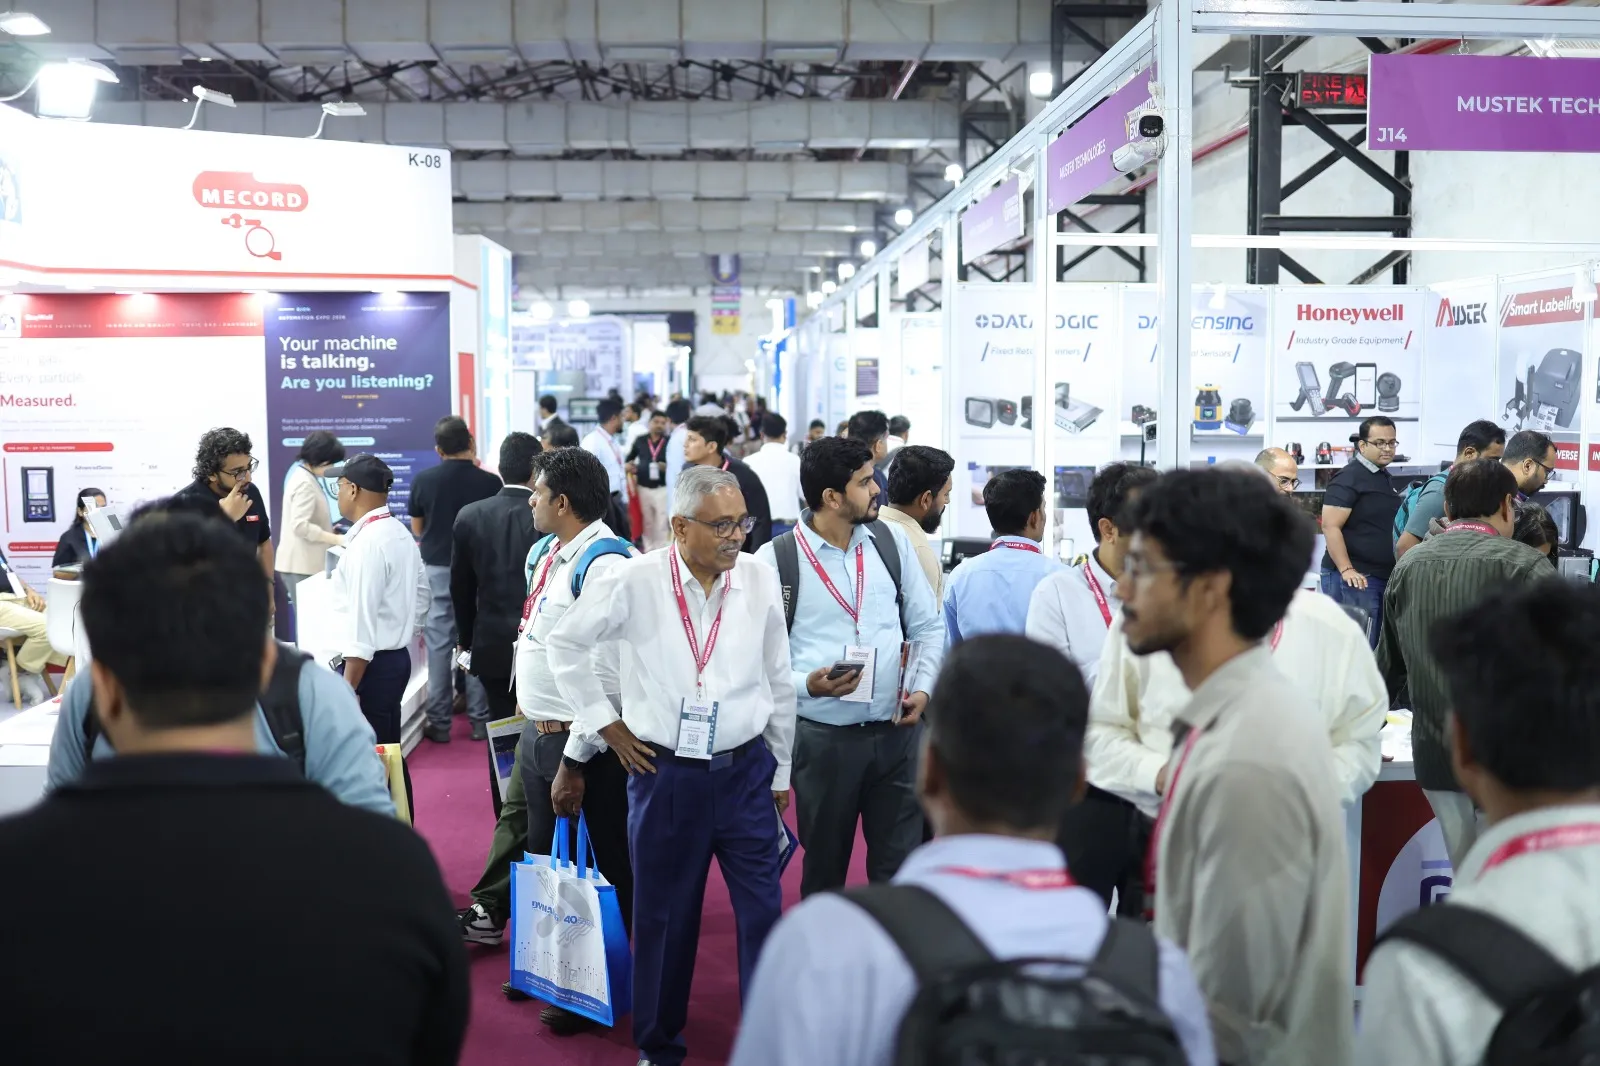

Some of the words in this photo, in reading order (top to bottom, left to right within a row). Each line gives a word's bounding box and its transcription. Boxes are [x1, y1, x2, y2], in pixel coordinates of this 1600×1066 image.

[1303, 75, 1341, 88] FIRE
[1302, 90, 1341, 102] EXIT
[1457, 96, 1543, 113] MUSTEK
[1549, 97, 1600, 114] TECH
[1377, 128, 1408, 142] J14
[408, 153, 441, 169] K-08
[1059, 158, 1075, 180] MUSTEK
[1075, 138, 1106, 171] TECHNOLOGIES
[202, 188, 302, 208] MECORD
[1510, 300, 1538, 316] Smart
[1540, 296, 1582, 313] Labeling
[992, 314, 1099, 329] DATOGIC
[1297, 304, 1404, 325] Honeywell
[279, 336, 319, 351] Your
[324, 335, 398, 351] machine
[1296, 336, 1329, 346] Industry
[1331, 336, 1357, 345] Grade
[1359, 336, 1404, 346] Equipment
[991, 346, 1013, 355] Fixed
[280, 355, 297, 369] is
[302, 354, 375, 372] talking.
[281, 376, 310, 389] Are
[316, 377, 346, 392] you
[351, 374, 434, 390] listening?
[0, 394, 77, 407] Measured.
[1556, 450, 1579, 461] VERSE
[564, 914, 578, 925] 40
